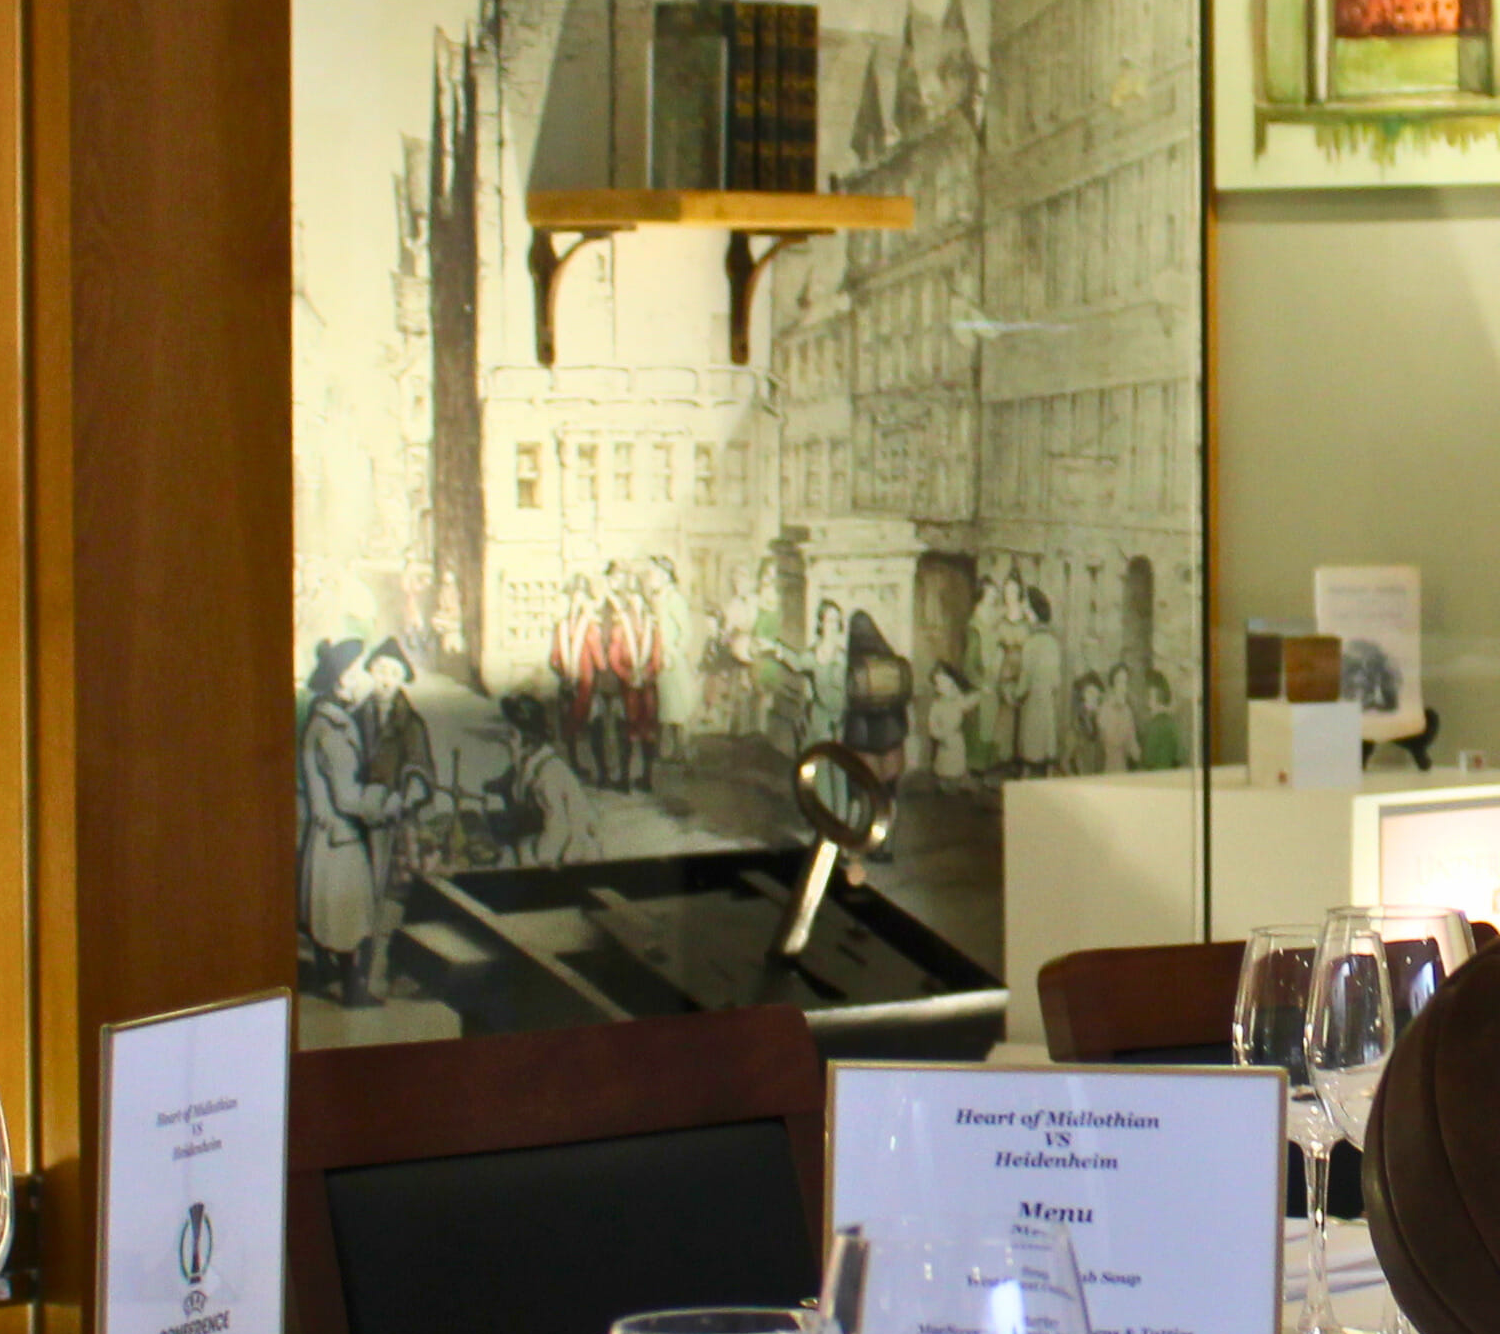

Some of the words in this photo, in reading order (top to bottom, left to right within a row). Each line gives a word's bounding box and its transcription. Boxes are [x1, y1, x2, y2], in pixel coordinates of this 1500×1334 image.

[956, 1107, 1017, 1126] Heart
[1019, 1108, 1046, 1130] of
[1046, 1110, 1160, 1130] Midlothian
[1045, 1131, 1072, 1148] VS
[995, 1151, 1119, 1170] Heidenheim
[1019, 1201, 1094, 1224] Menu
